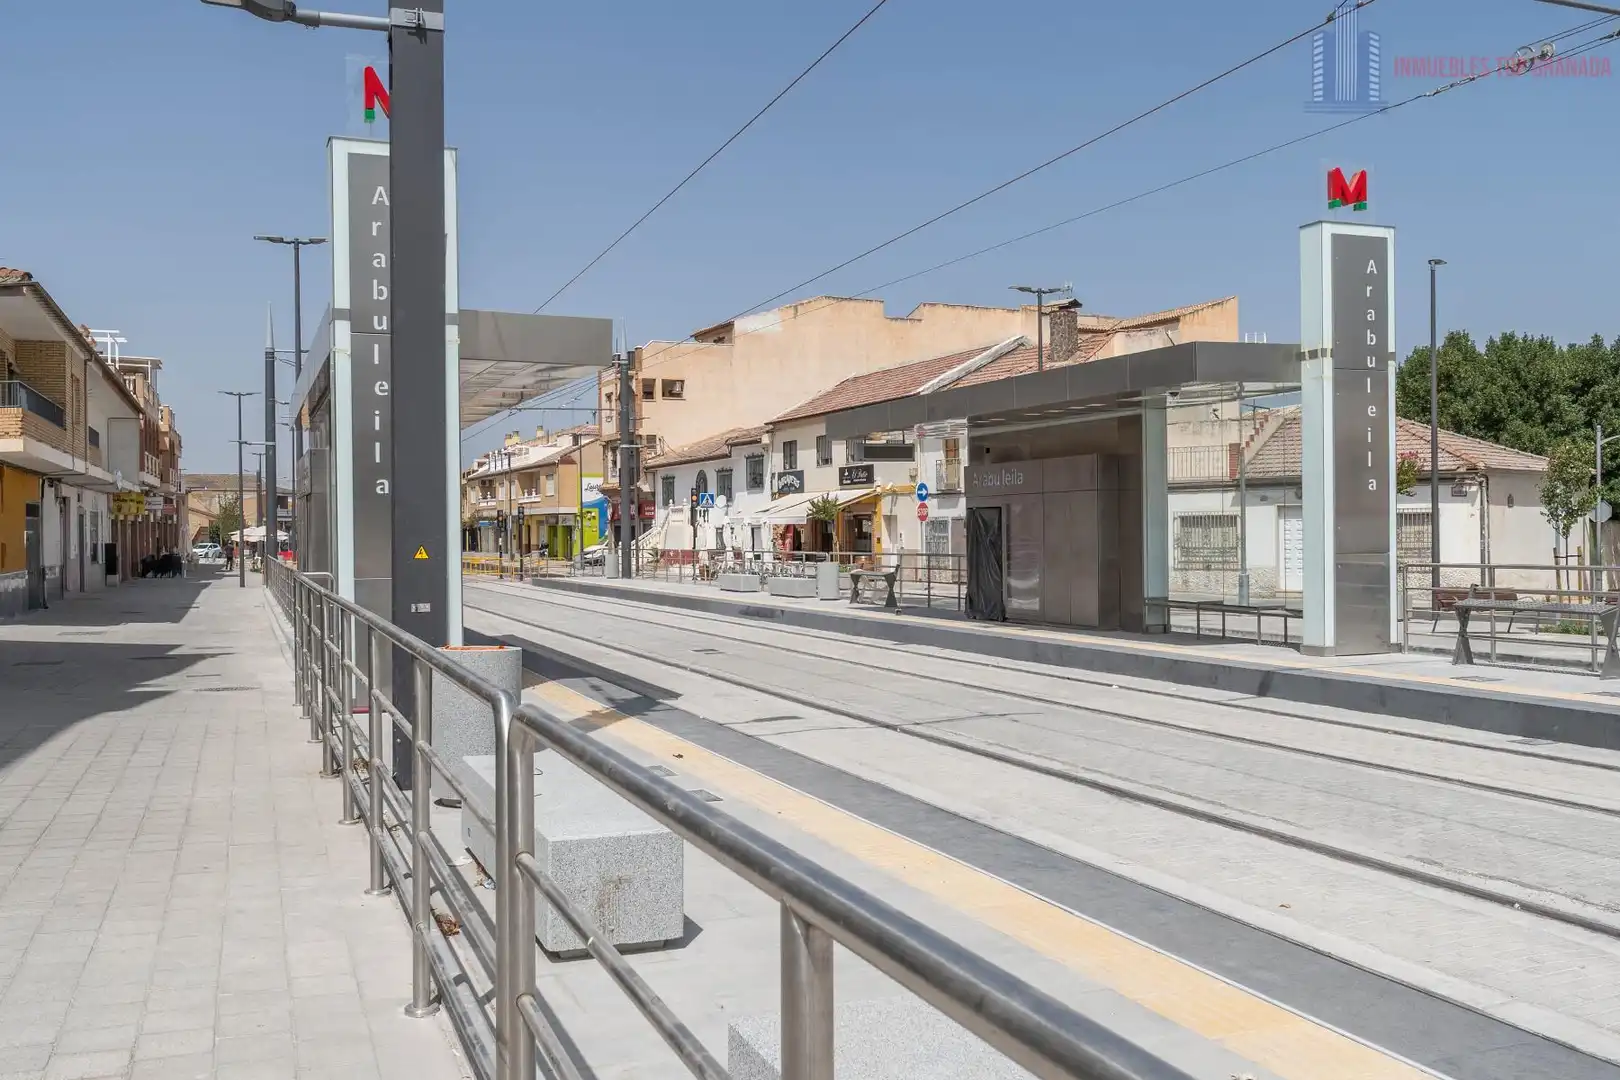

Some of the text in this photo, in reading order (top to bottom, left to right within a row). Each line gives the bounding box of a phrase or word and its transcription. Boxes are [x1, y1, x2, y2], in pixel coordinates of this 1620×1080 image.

[1327, 166, 1368, 211] M
[370, 185, 391, 495] Arabuleila
[1366, 259, 1378, 491] Arabuleila
